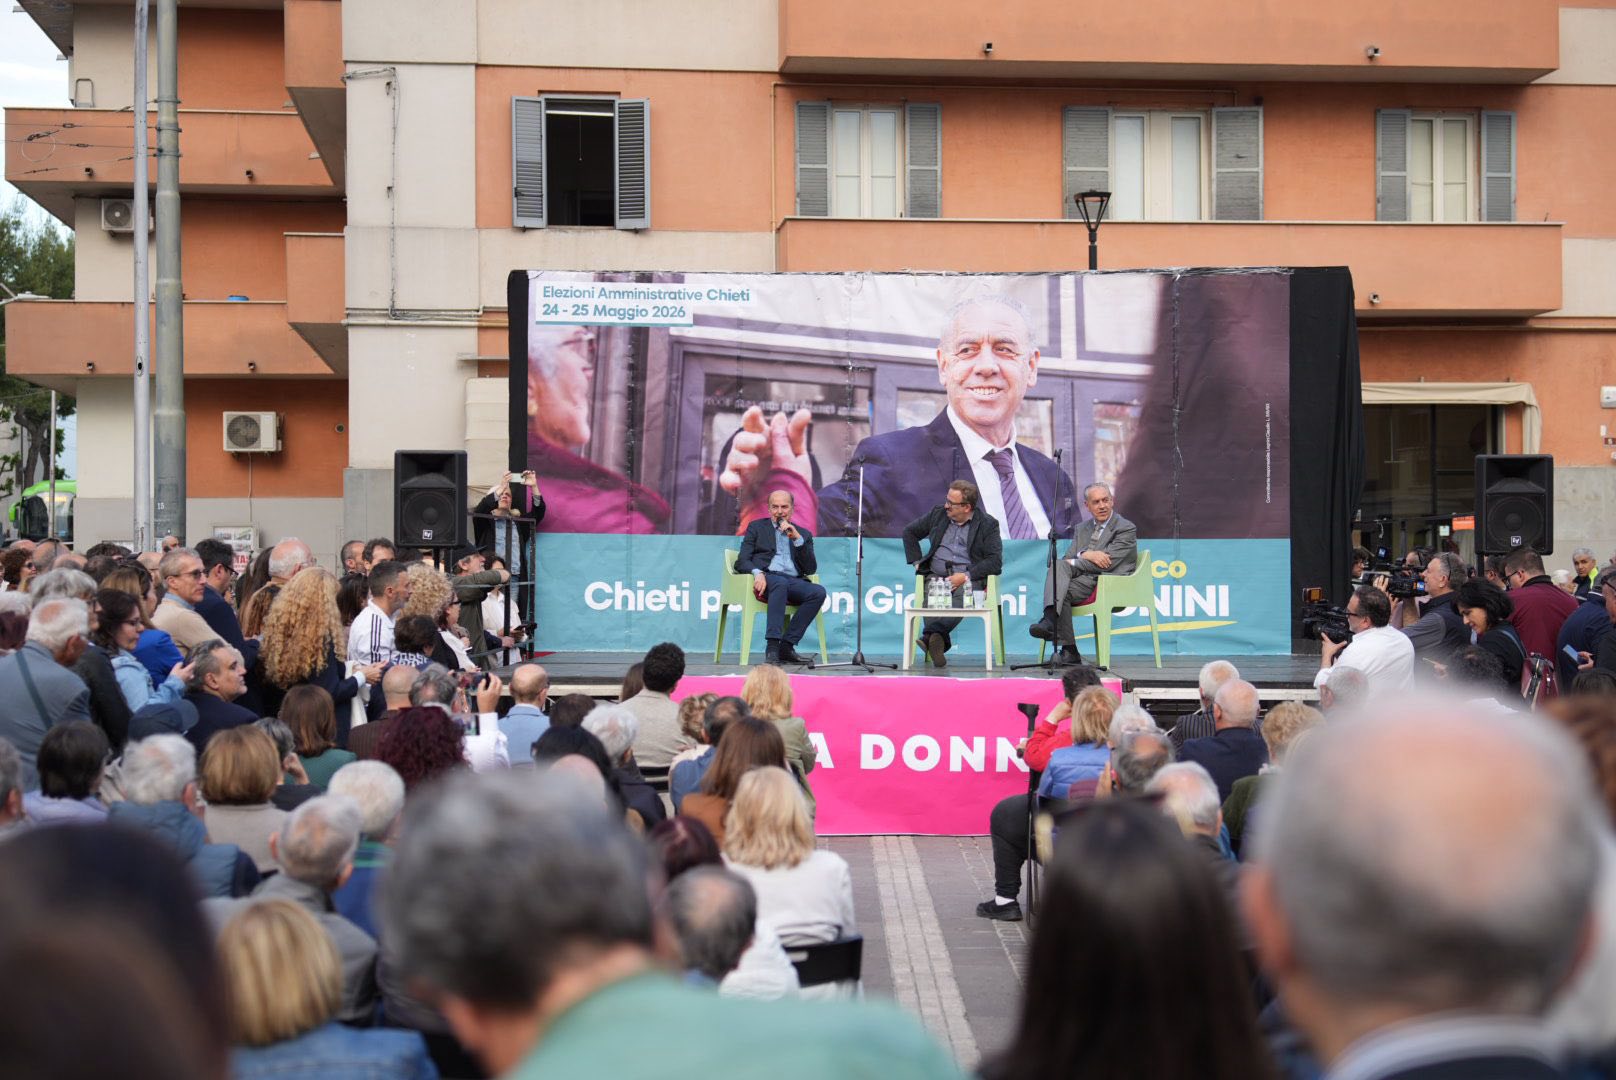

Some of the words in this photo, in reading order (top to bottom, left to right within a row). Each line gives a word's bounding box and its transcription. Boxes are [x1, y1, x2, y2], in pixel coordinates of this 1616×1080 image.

[543, 286, 595, 298] Elezioni
[598, 287, 703, 300] Amministrative
[706, 289, 750, 301] Chieti
[542, 304, 559, 316] 24
[571, 304, 589, 316] 25
[593, 304, 649, 320] Maggio
[652, 306, 686, 318] 2026
[584, 581, 690, 612] Chieti
[860, 733, 1030, 773] DONN
